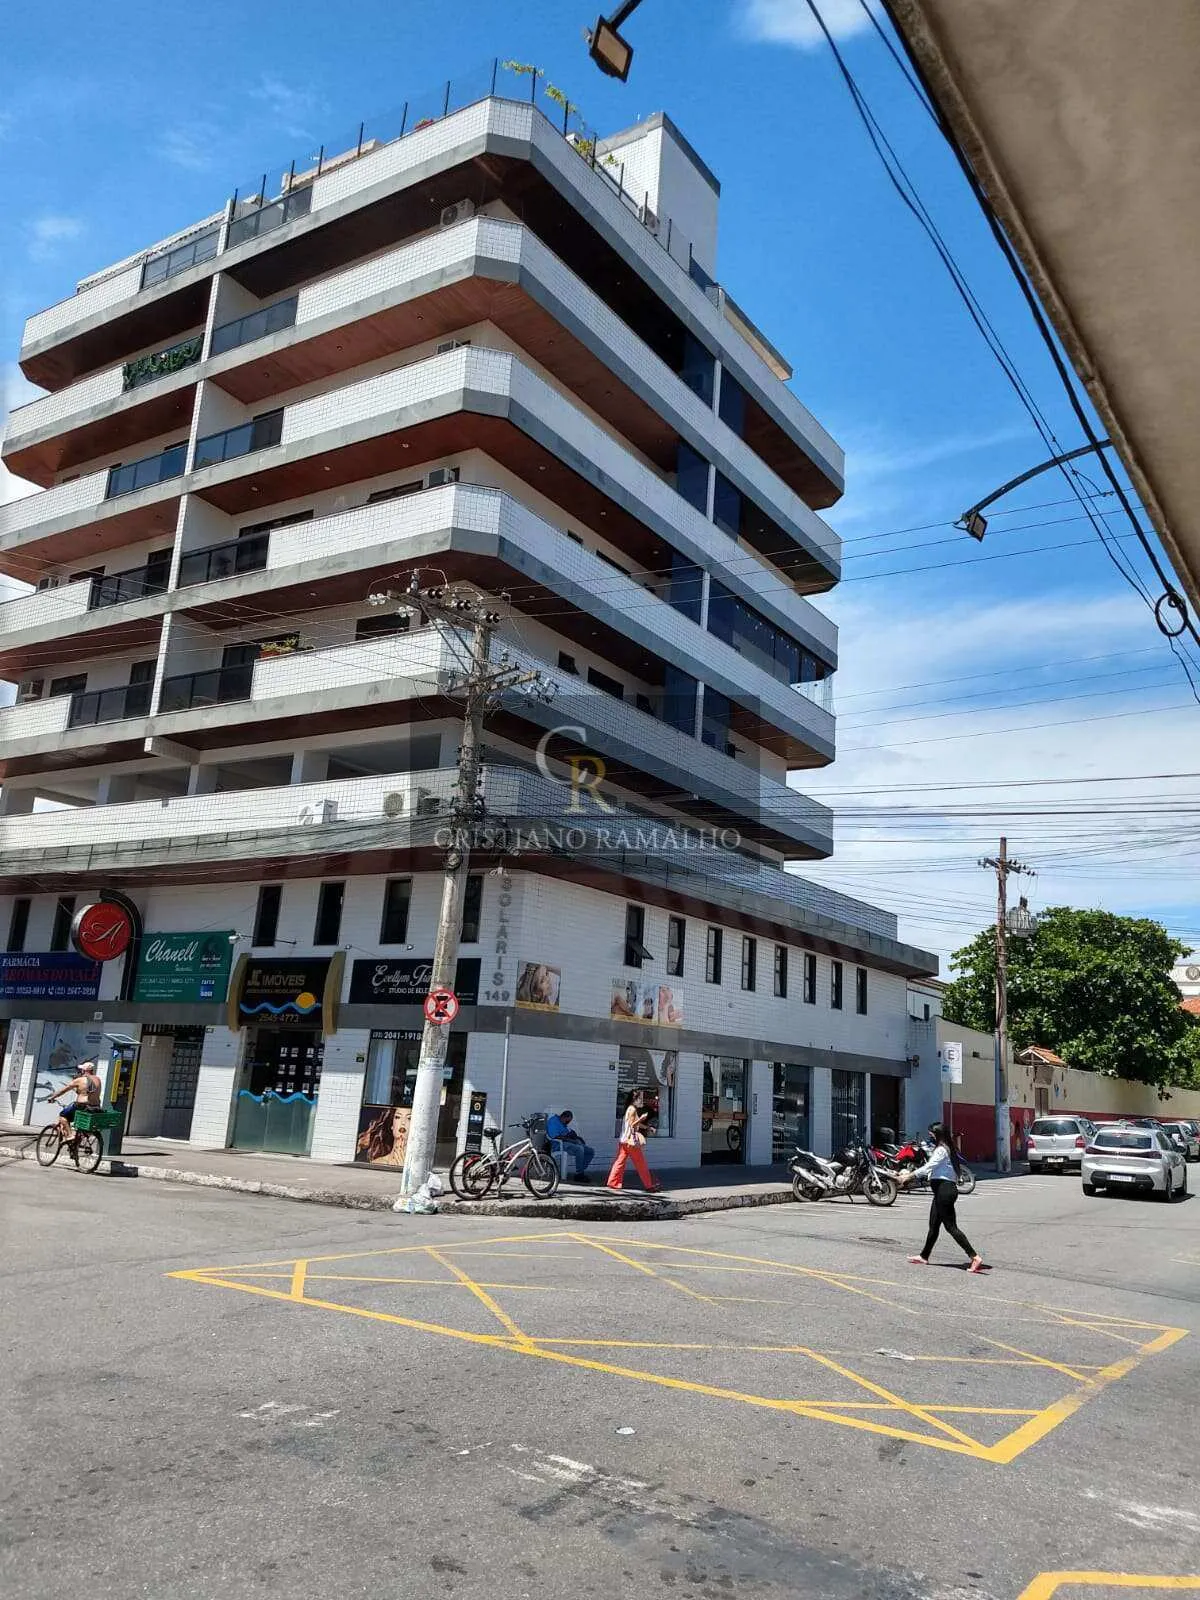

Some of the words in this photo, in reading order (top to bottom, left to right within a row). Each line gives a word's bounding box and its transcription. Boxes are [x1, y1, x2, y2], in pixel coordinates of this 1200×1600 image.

[492, 877, 513, 987] SOLARIS
[145, 939, 200, 962] Chanell
[2, 955, 41, 967] FARMÁCIA
[262, 969, 307, 987] IMÓVEIS
[484, 990, 510, 1001] 149
[948, 1049, 955, 1060] E
